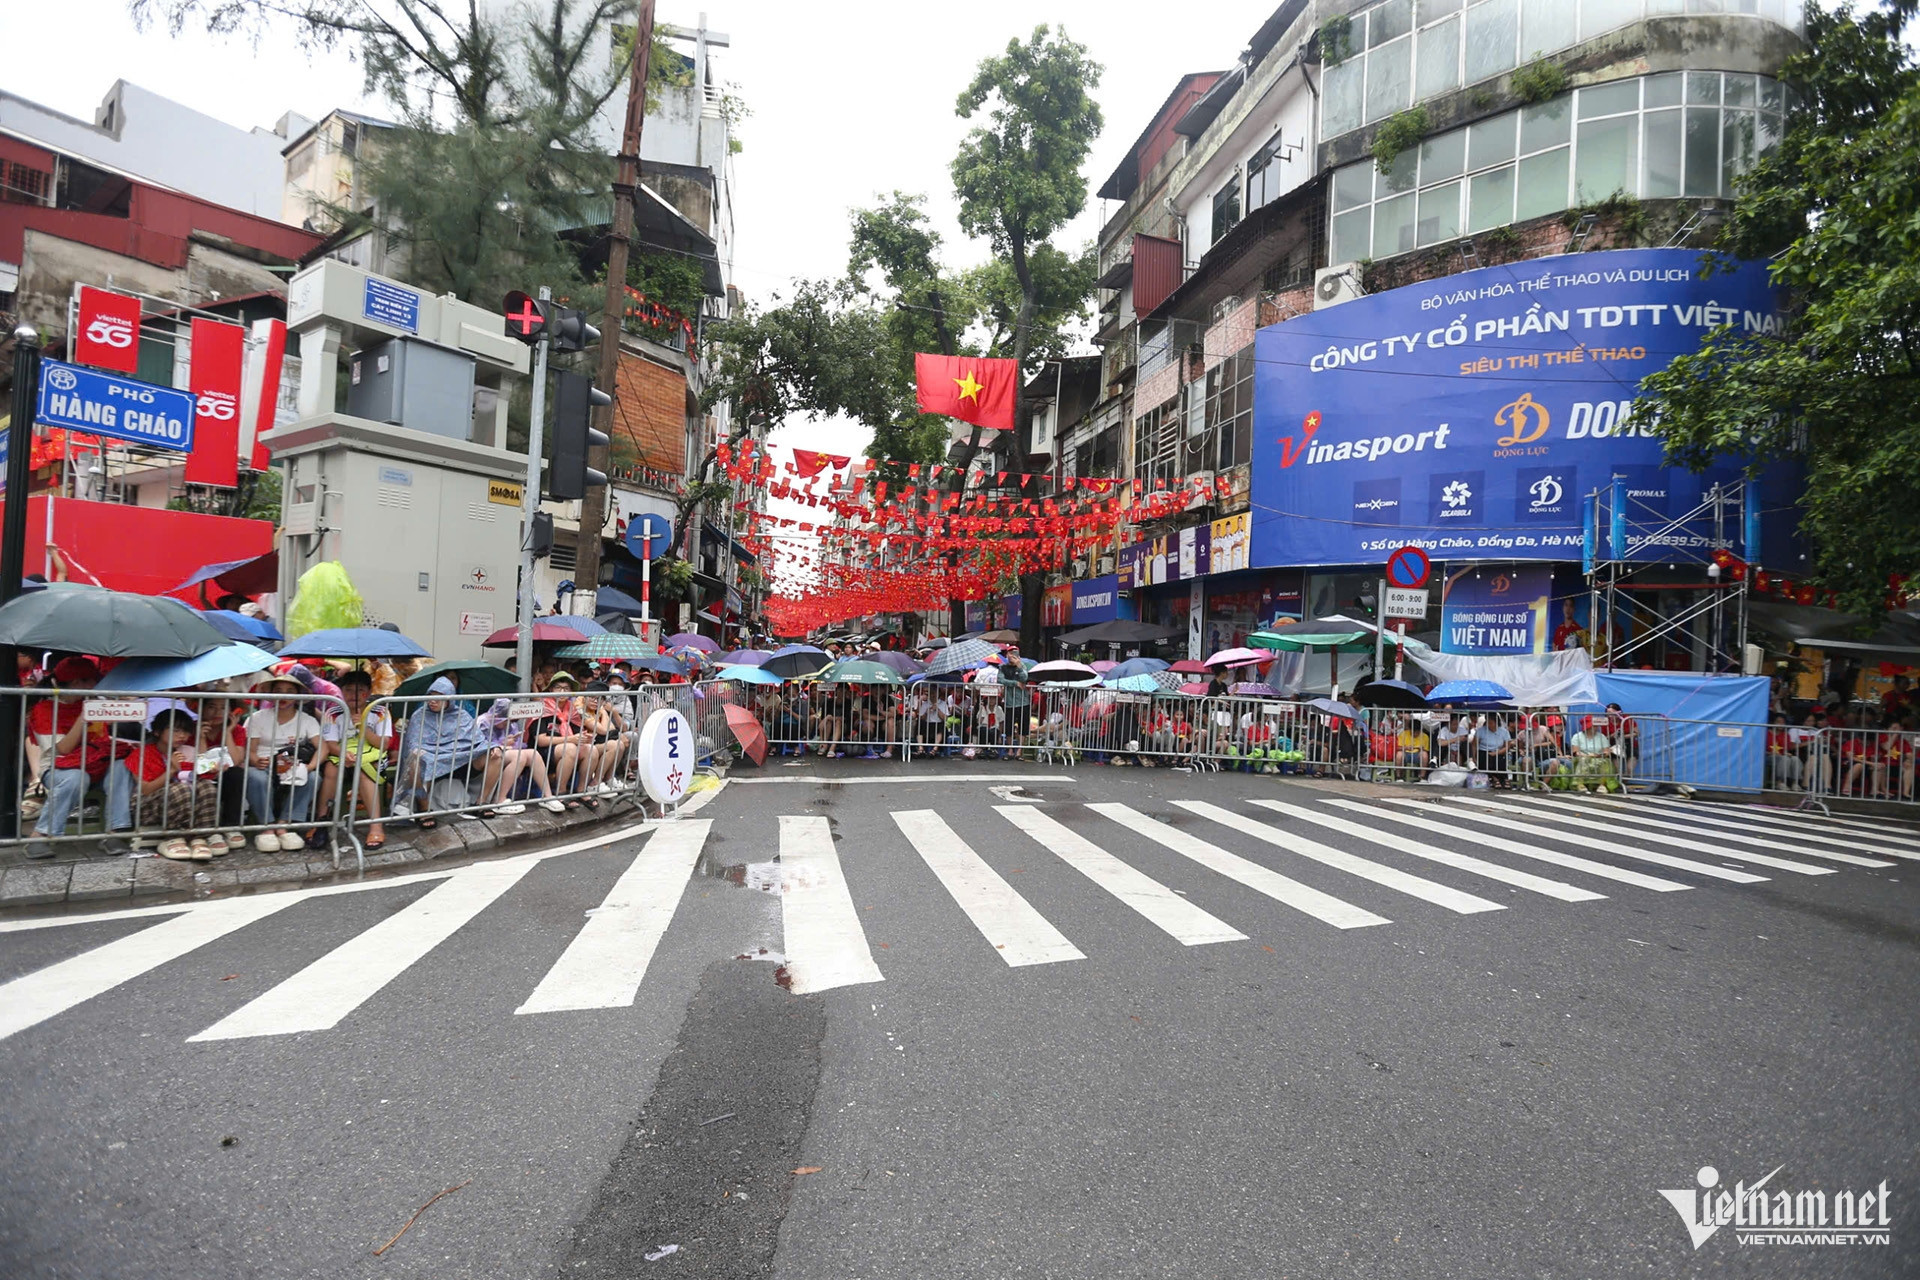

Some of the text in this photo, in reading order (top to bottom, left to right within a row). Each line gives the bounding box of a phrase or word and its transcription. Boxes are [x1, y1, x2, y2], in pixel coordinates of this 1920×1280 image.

[1421, 268, 1689, 310] BỘ VĂN HÓA THỂ THAO VÀ DU LỊCH
[96, 313, 133, 327] viettel
[86, 321, 133, 348] 5G
[1310, 341, 1377, 372] CÔNG
[1382, 332, 1422, 356] TY
[1427, 313, 1468, 349] CỔ
[1475, 302, 1569, 341] PHẦN
[1576, 304, 1668, 328] TDTT
[1673, 300, 1739, 331] VIỆT
[1460, 354, 1503, 375] SIÊU
[1507, 354, 1539, 370] THỊ
[1588, 346, 1646, 362] THAO
[108, 384, 158, 404] PHỐ
[203, 389, 236, 401] viettel
[50, 393, 182, 440] HÀNG CHÁO
[196, 396, 236, 420] 5G
[1278, 410, 1450, 469] Vinasport
[1493, 446, 1549, 459] ĐỘNG LỰC
[1369, 534, 1585, 550] Số 04 Hàng Cháo, Đống Đa, Hà Nộ
[1388, 606, 1404, 614] 16:00
[1391, 594, 1404, 602] 6:00
[1408, 595, 1422, 603] 9:00
[1452, 611, 1529, 625] BÓNG ĐỘNG LỰC SỐ
[1452, 625, 1527, 649] VIỆT NAM
[668, 716, 679, 759] MB
